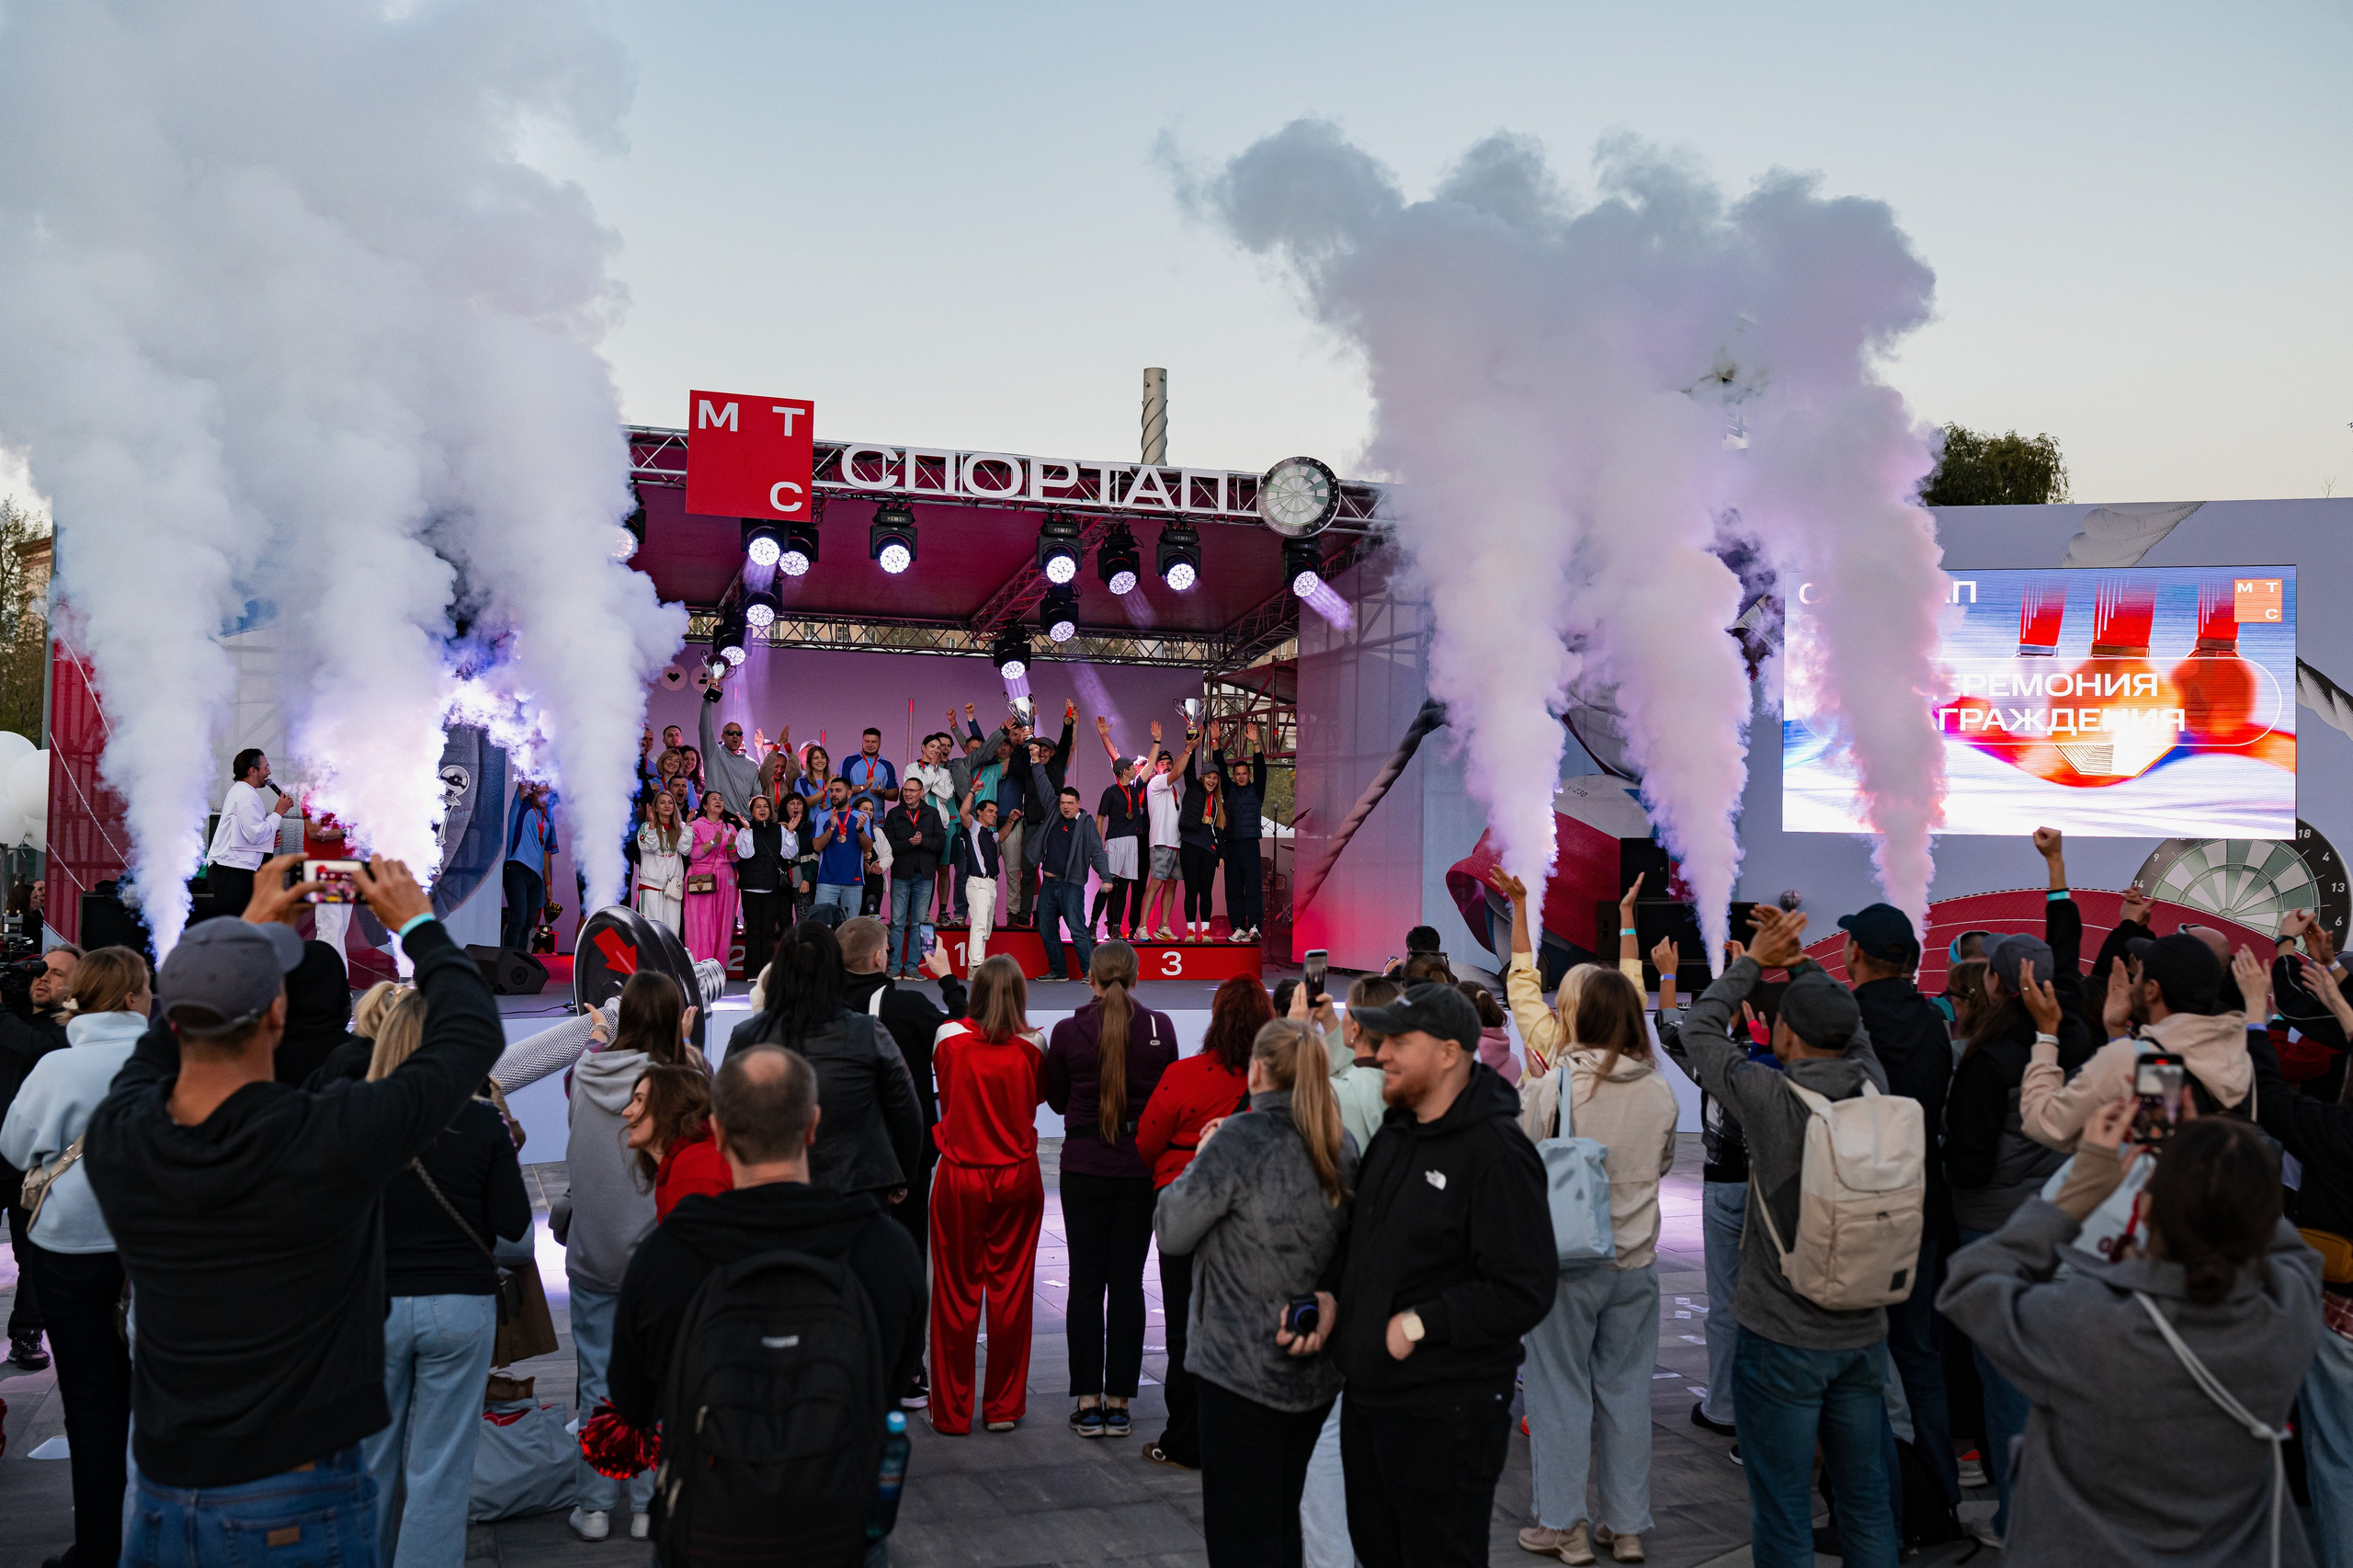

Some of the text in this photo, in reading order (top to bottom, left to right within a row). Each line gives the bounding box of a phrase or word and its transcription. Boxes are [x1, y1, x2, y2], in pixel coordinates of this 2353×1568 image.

[841, 443, 1229, 515] СПОРТАП
[1933, 673, 2158, 700] ЕРЕМОНИЯ
[1935, 708, 2186, 735] ГРАЖДЕНИЯ
[2298, 829, 2312, 838] 18
[2153, 853, 2160, 862] 9
[2322, 852, 2330, 862] 4
[2331, 882, 2346, 892] 13
[2335, 916, 2343, 926] 6
[726, 945, 745, 971] 2
[954, 942, 966, 967] 1
[1161, 951, 1183, 976] 3
